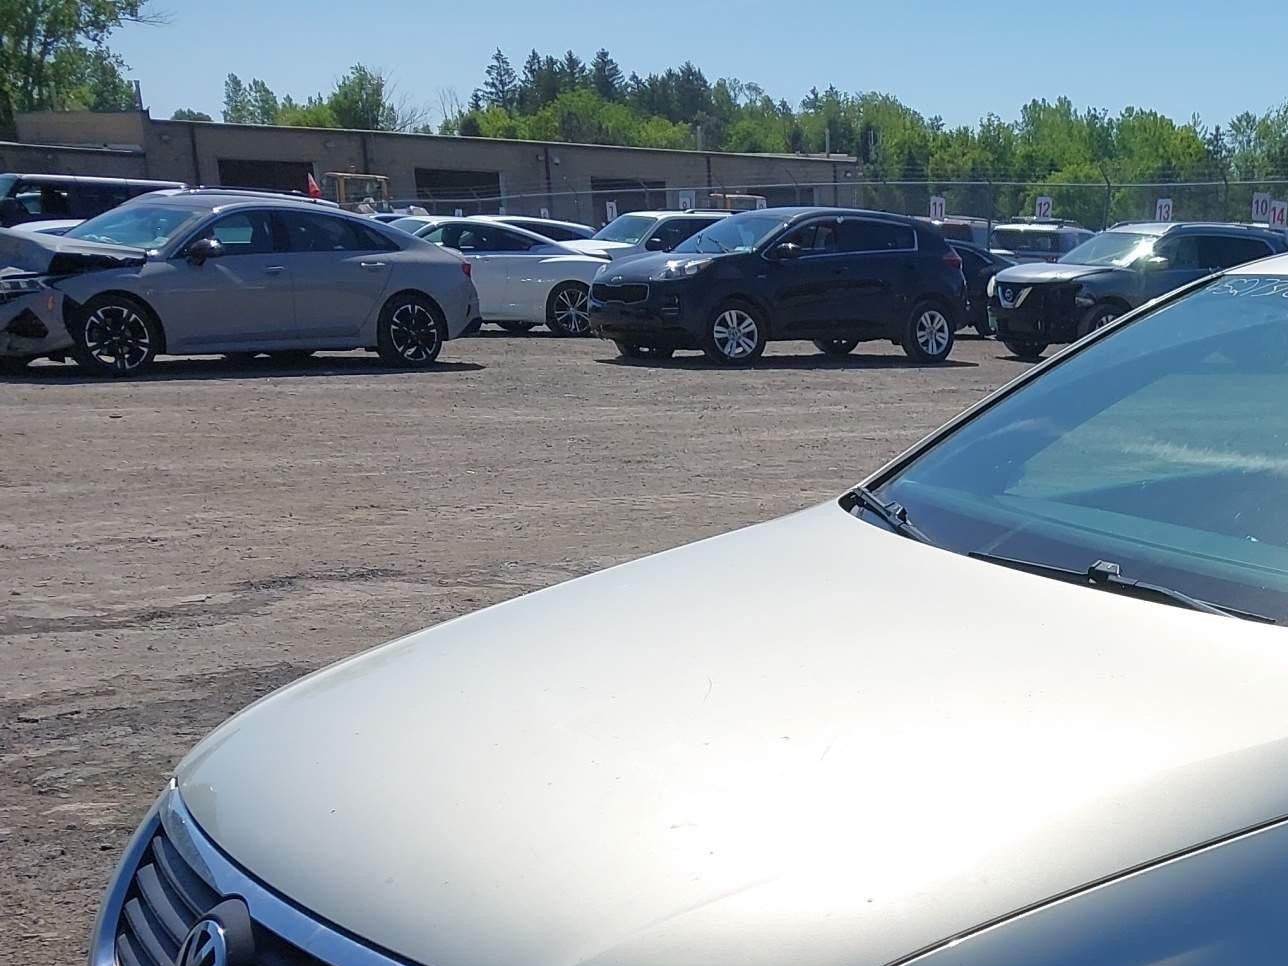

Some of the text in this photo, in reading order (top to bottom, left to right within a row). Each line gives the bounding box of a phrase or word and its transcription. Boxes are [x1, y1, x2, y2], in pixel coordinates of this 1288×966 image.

[932, 201, 944, 218] 11
[1037, 201, 1050, 218] 12
[1158, 204, 1170, 221] 13
[1254, 200, 1268, 216] 10
[1271, 207, 1285, 225] 14
